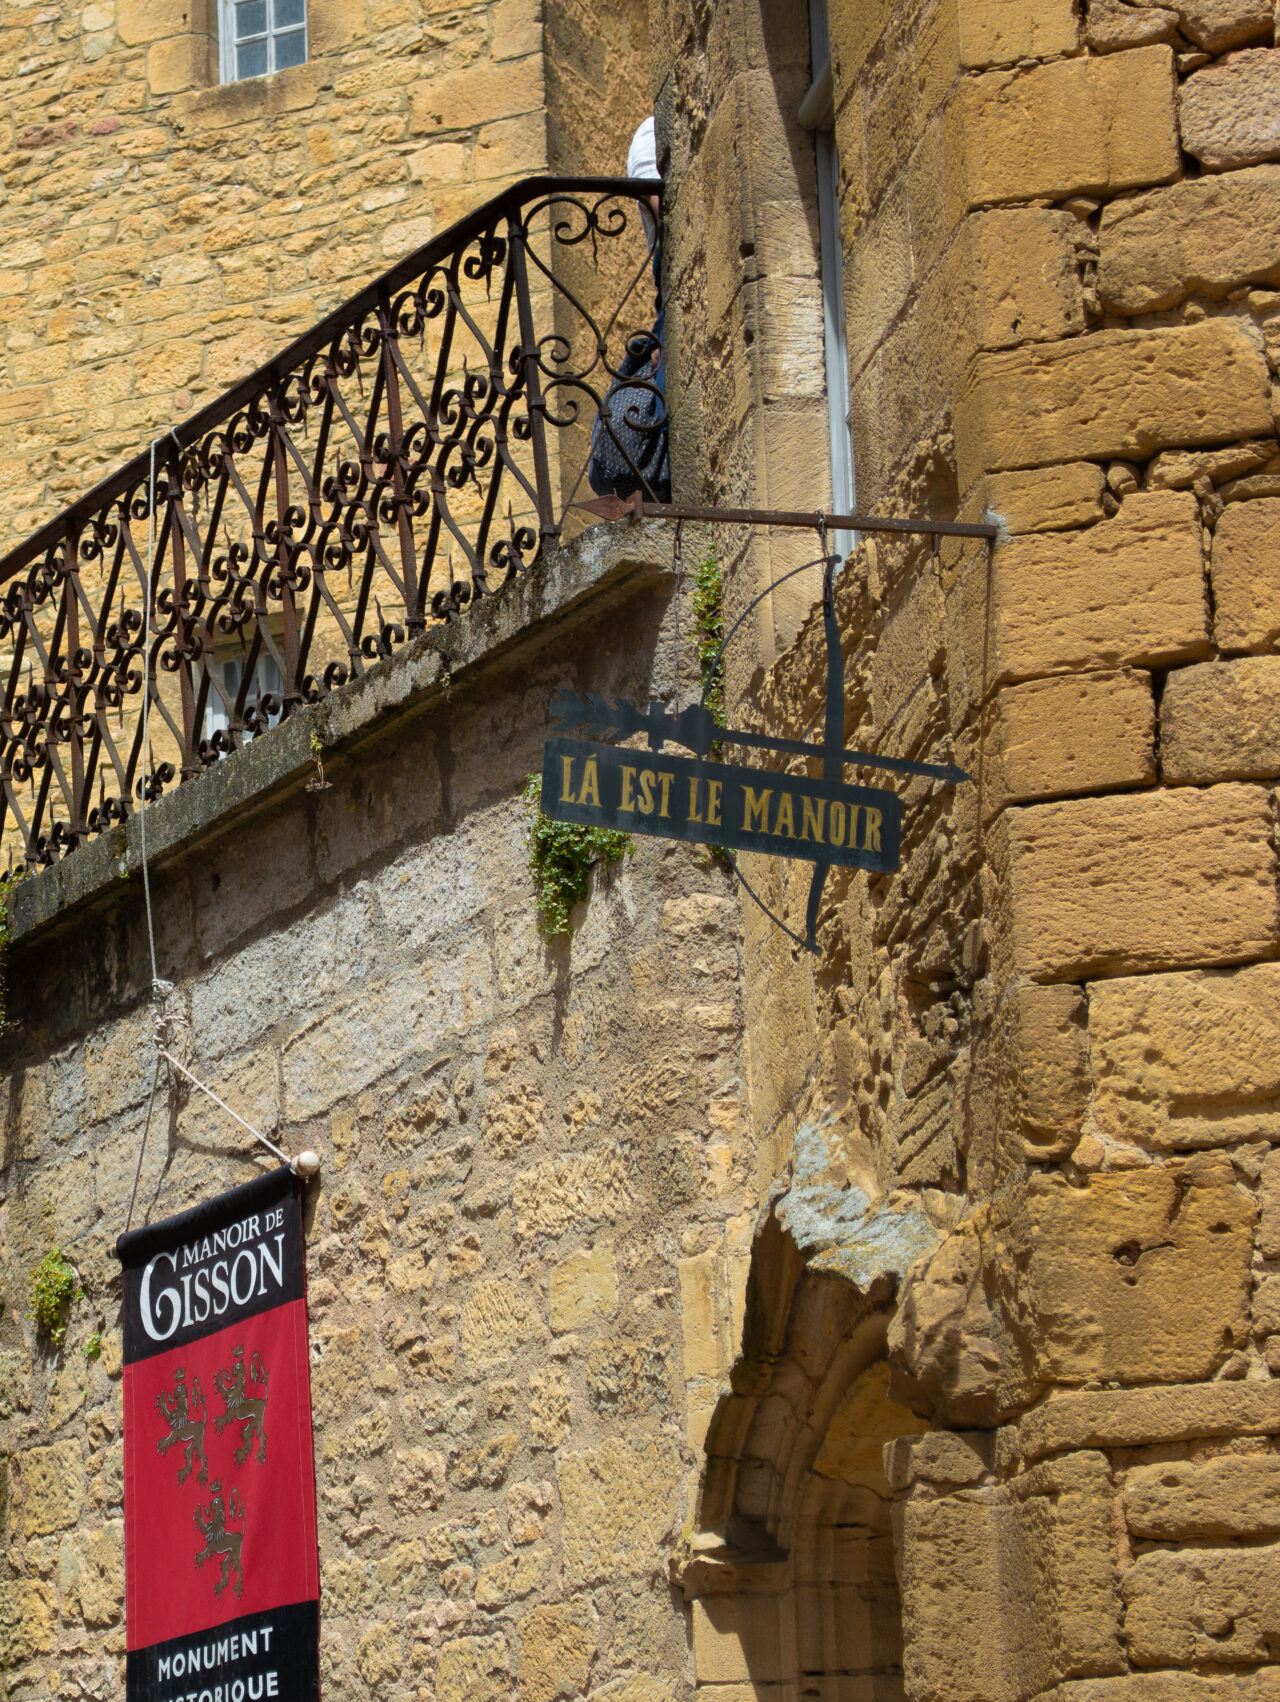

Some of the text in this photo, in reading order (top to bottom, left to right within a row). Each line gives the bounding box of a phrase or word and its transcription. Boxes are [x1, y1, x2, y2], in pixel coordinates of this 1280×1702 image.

[617, 764, 675, 819] EST
[687, 776, 723, 826] LE
[739, 784, 883, 854] MANOIR
[182, 1208, 284, 1268] MANOIR DE
[139, 1233, 285, 1341] GISSON
[158, 1626, 273, 1682] MONUMENT
